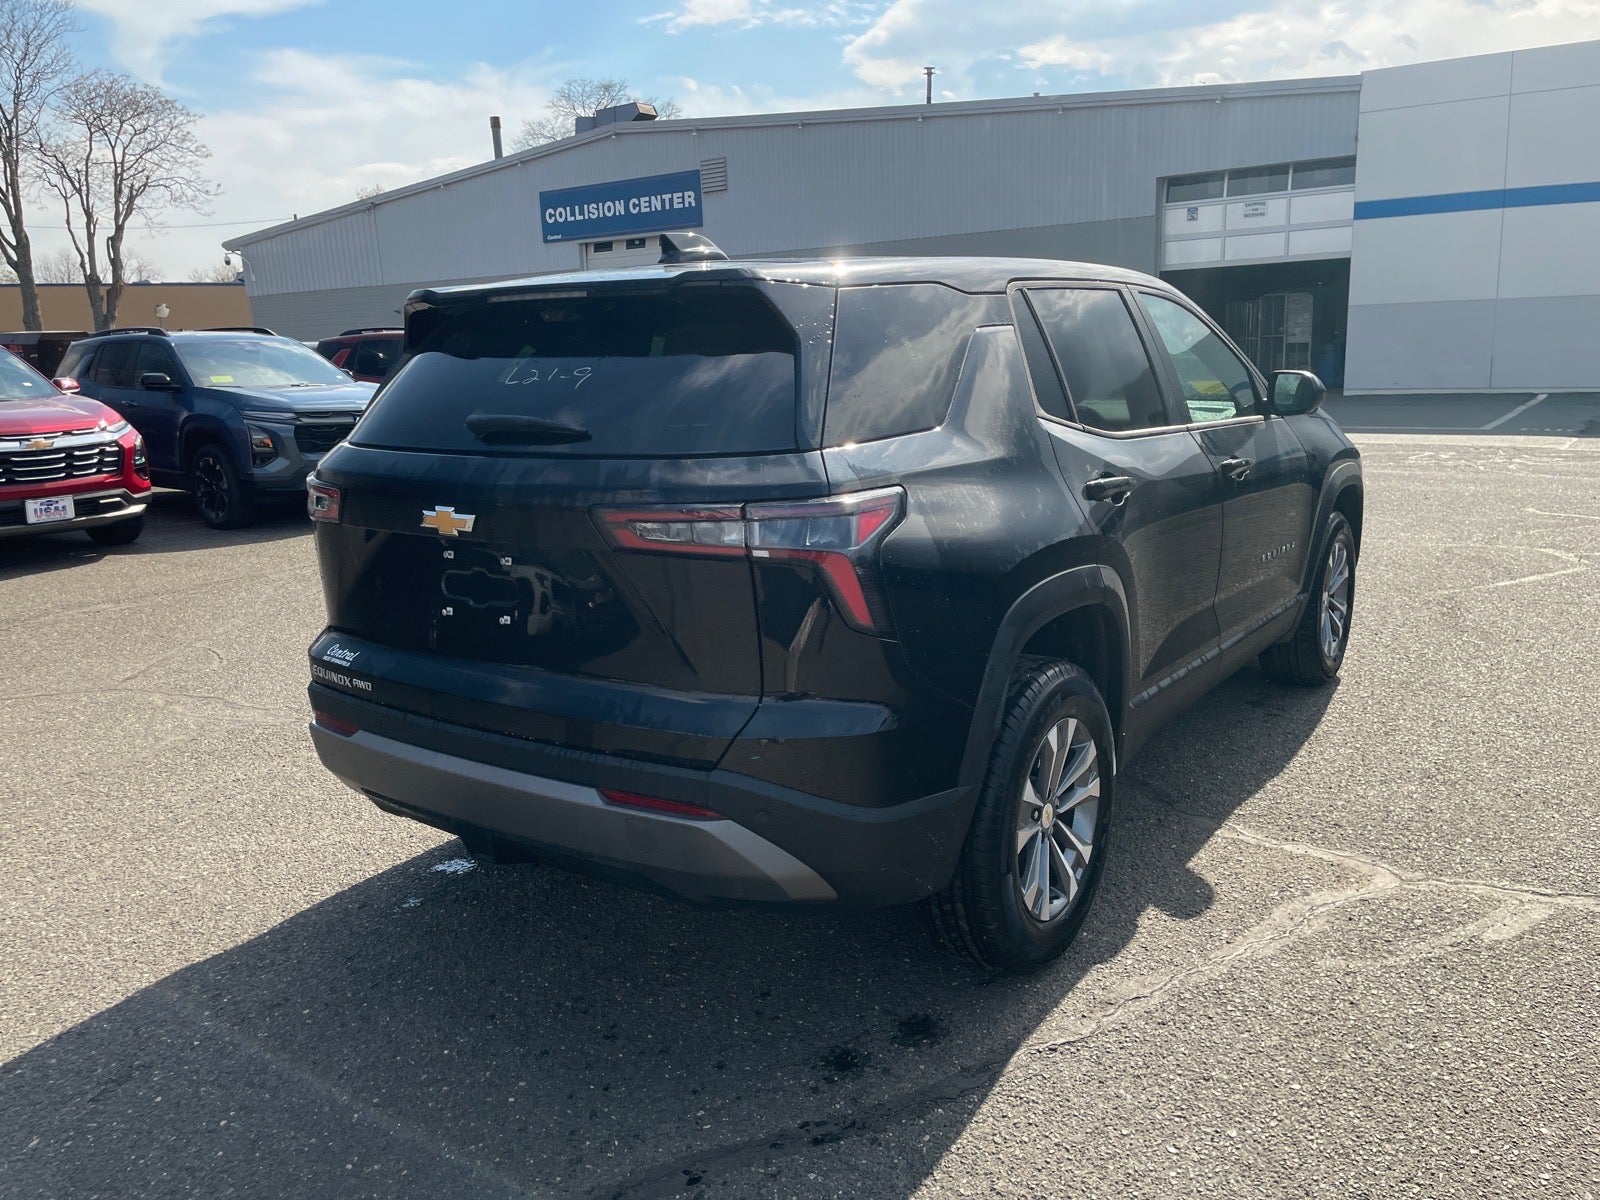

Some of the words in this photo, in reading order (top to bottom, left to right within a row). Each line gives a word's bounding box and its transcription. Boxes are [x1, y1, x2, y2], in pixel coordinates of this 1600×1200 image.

[545, 199, 624, 224] COLLISION
[629, 191, 696, 214] CENTER
[505, 367, 592, 389] L21-9
[327, 643, 361, 661] Central
[313, 664, 352, 688] EQUINOX
[352, 678, 372, 691] AWD
